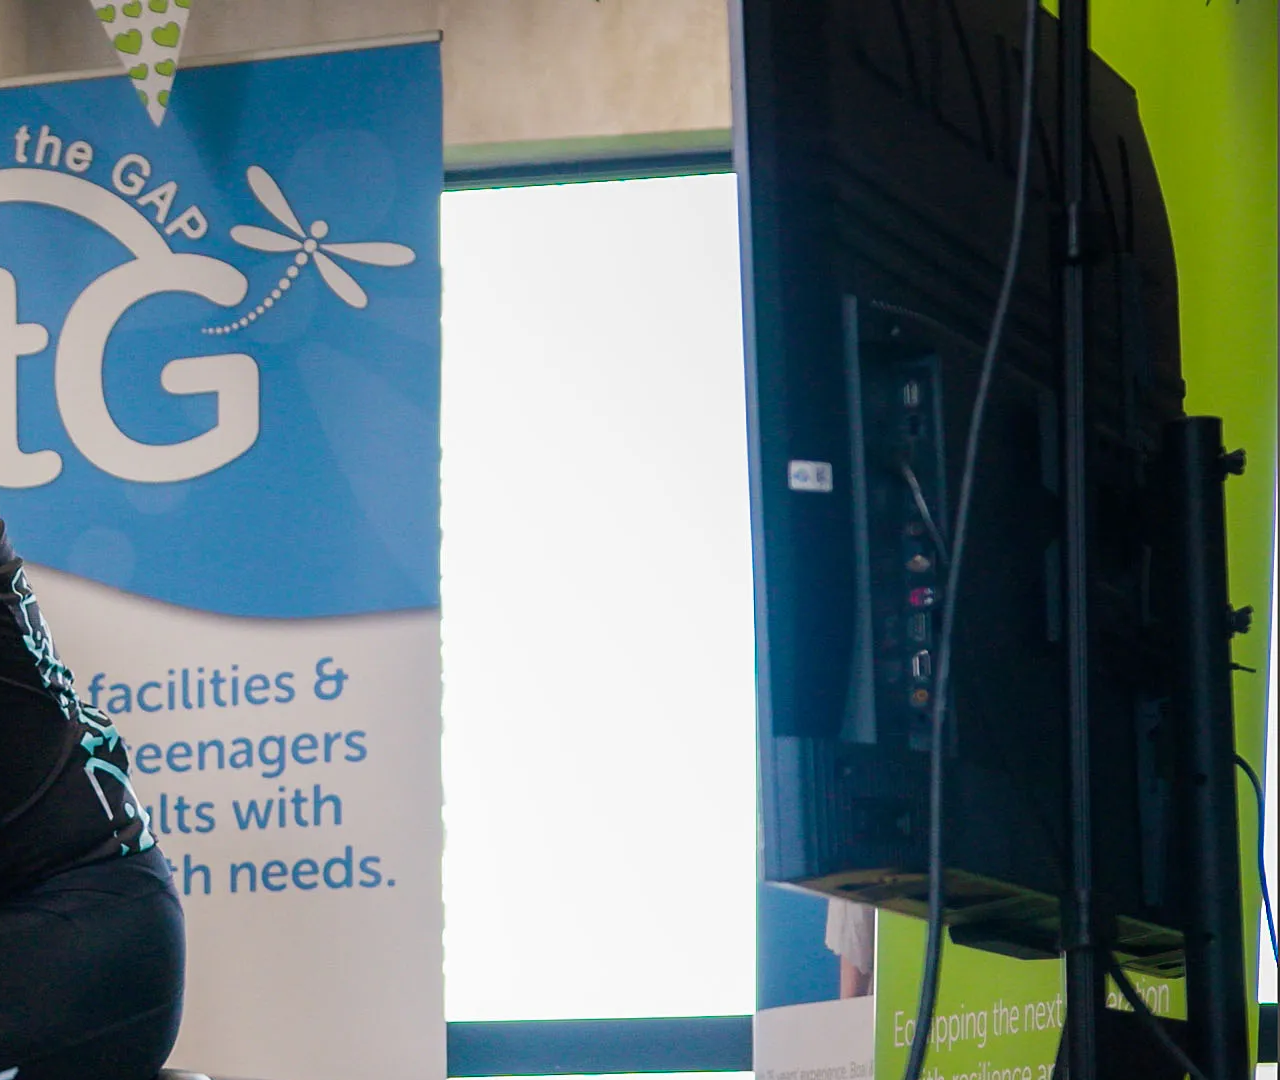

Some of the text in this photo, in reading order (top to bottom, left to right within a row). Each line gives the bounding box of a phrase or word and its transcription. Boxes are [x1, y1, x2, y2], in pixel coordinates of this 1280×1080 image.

[13, 124, 94, 174] the
[110, 151, 210, 243] GAP
[88, 656, 349, 716] facilities &
[132, 729, 369, 779] eenagers
[232, 783, 344, 831] with
[229, 845, 397, 893] needs.
[893, 1003, 988, 1053] Eqipping
[992, 998, 1022, 1036] the
[1024, 992, 1063, 1032] next
